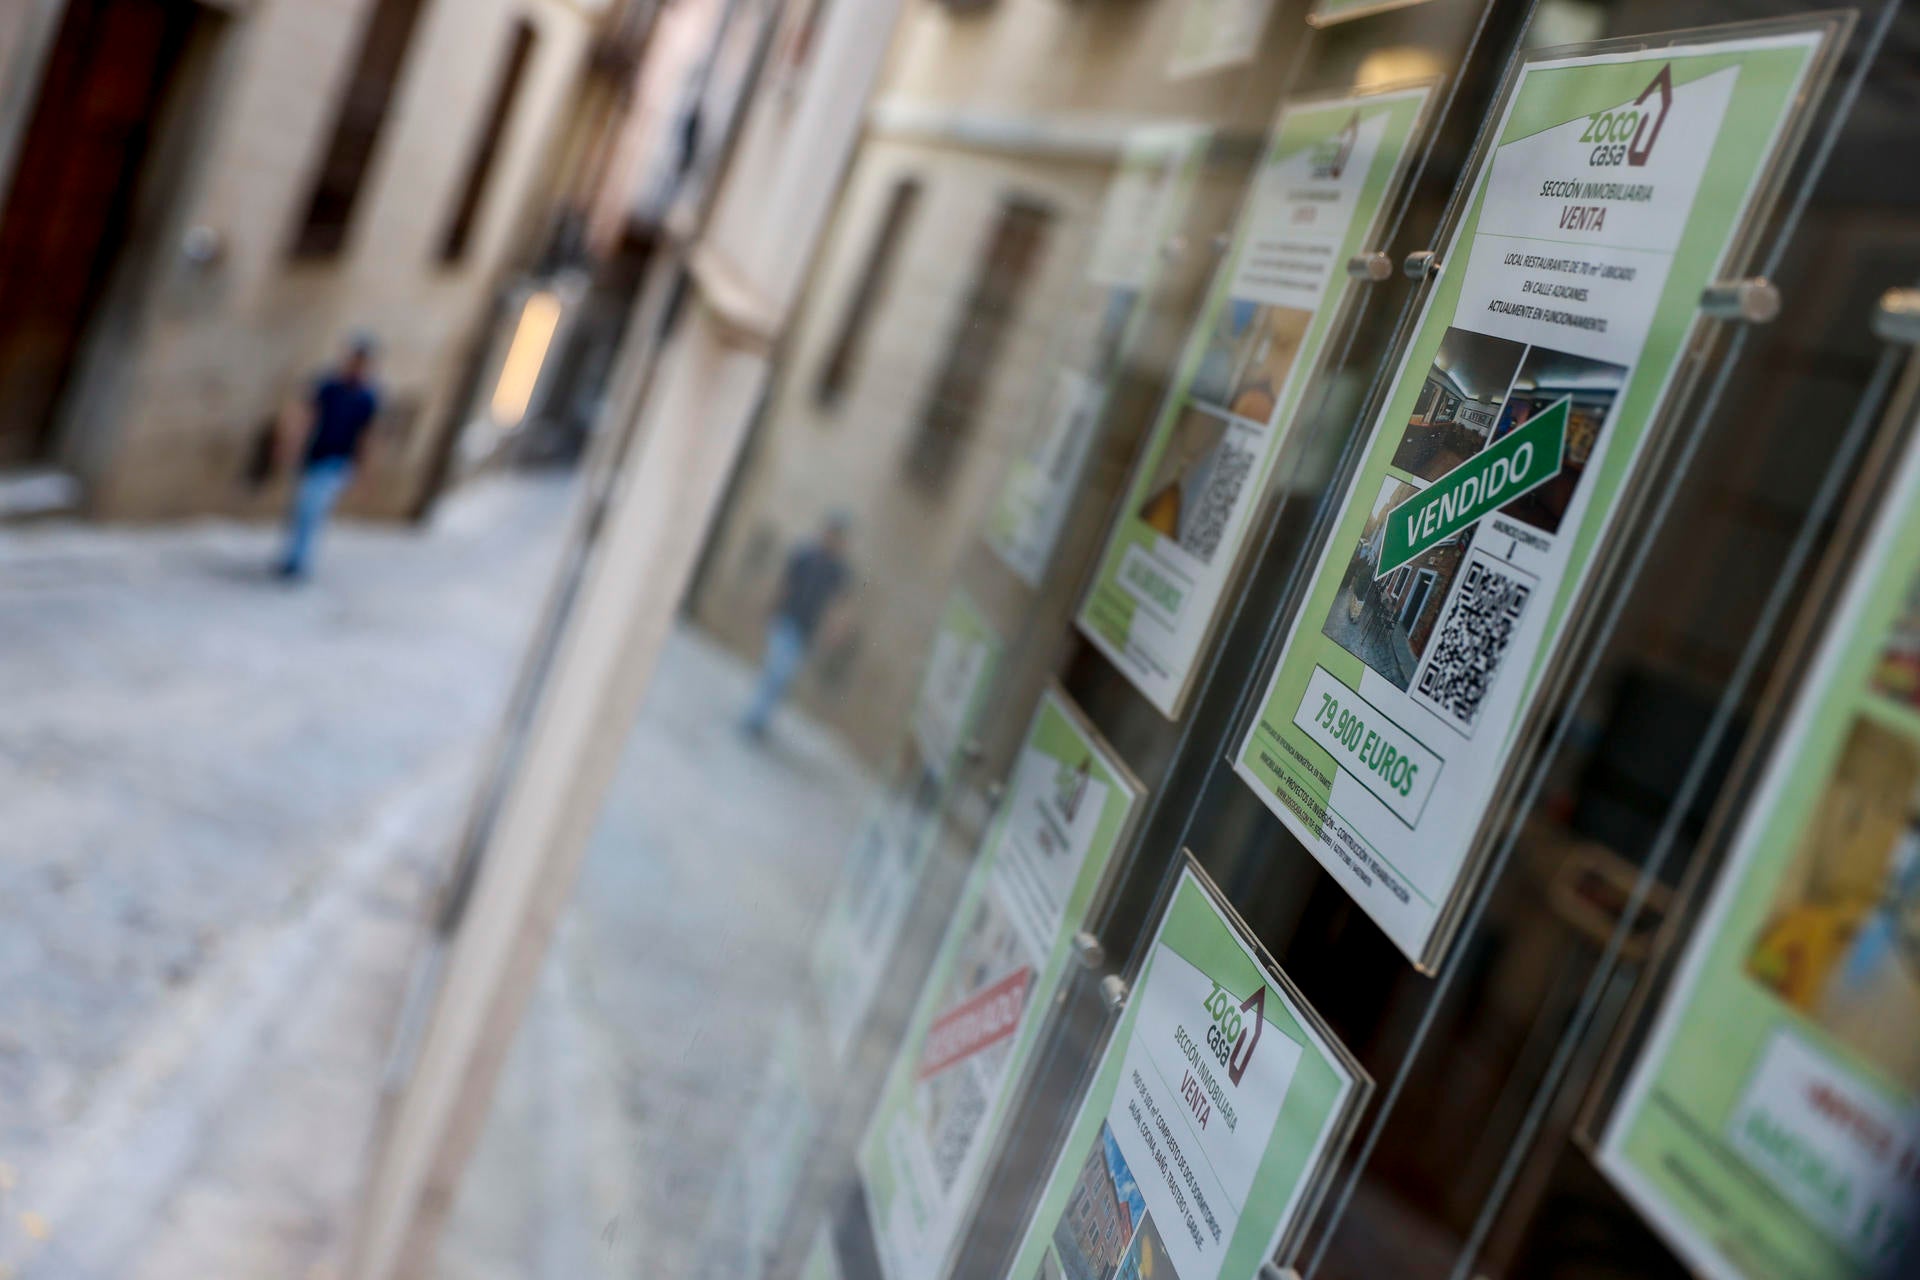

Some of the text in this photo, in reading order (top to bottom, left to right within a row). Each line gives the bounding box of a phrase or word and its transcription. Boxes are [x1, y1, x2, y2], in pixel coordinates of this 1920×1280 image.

[1588, 144, 1626, 167] casa
[1539, 178, 1655, 203] SECCIÓN INMOBILIARIA
[1559, 205, 1607, 232] VENTA
[1504, 253, 1523, 266] LOCAL
[1523, 255, 1570, 273] RESTAURANTE
[1568, 260, 1580, 274] DE
[1487, 300, 1535, 319] ACTUALMENTE
[1532, 307, 1544, 321] EN
[1522, 280, 1533, 293] EN
[1532, 282, 1553, 297] CALLE
[1407, 441, 1534, 547] VENDIDO
[1314, 692, 1419, 798] 79.900 EUROS
[1285, 776, 1310, 804] PROYECTOS
[1312, 802, 1336, 830] INVERSIÓN
[1206, 1024, 1231, 1069] casa
[1174, 1024, 1238, 1134] SECCIÓN INMOBILIARIA
[1180, 1068, 1211, 1132] VENTA
[1155, 1114, 1181, 1161] COMPUESTO
[1177, 1155, 1187, 1172] DE
[1183, 1165, 1195, 1187] DOS
[1166, 1170, 1187, 1214] TRASTERO
